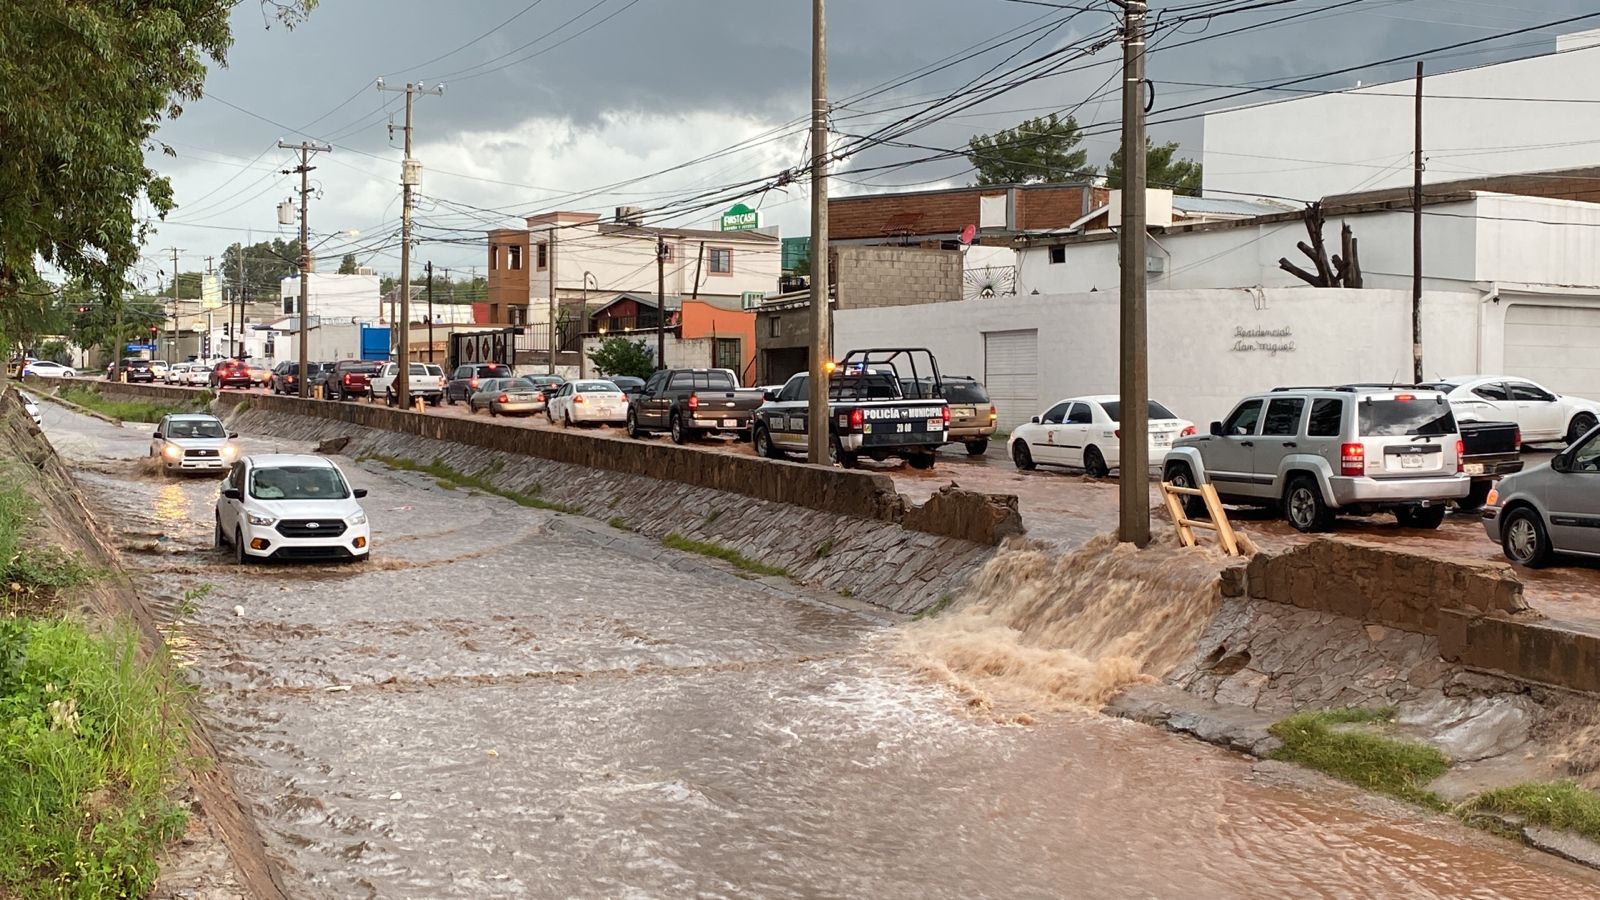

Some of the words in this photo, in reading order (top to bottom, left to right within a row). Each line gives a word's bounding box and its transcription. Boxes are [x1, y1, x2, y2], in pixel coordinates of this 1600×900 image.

[723, 215, 740, 227] FIRST
[740, 213, 756, 225] CASH
[1234, 324, 1292, 338] Residencial
[1230, 340, 1256, 352] San
[863, 408, 900, 419] POLICÍA
[908, 407, 943, 418] MUNICIPAL
